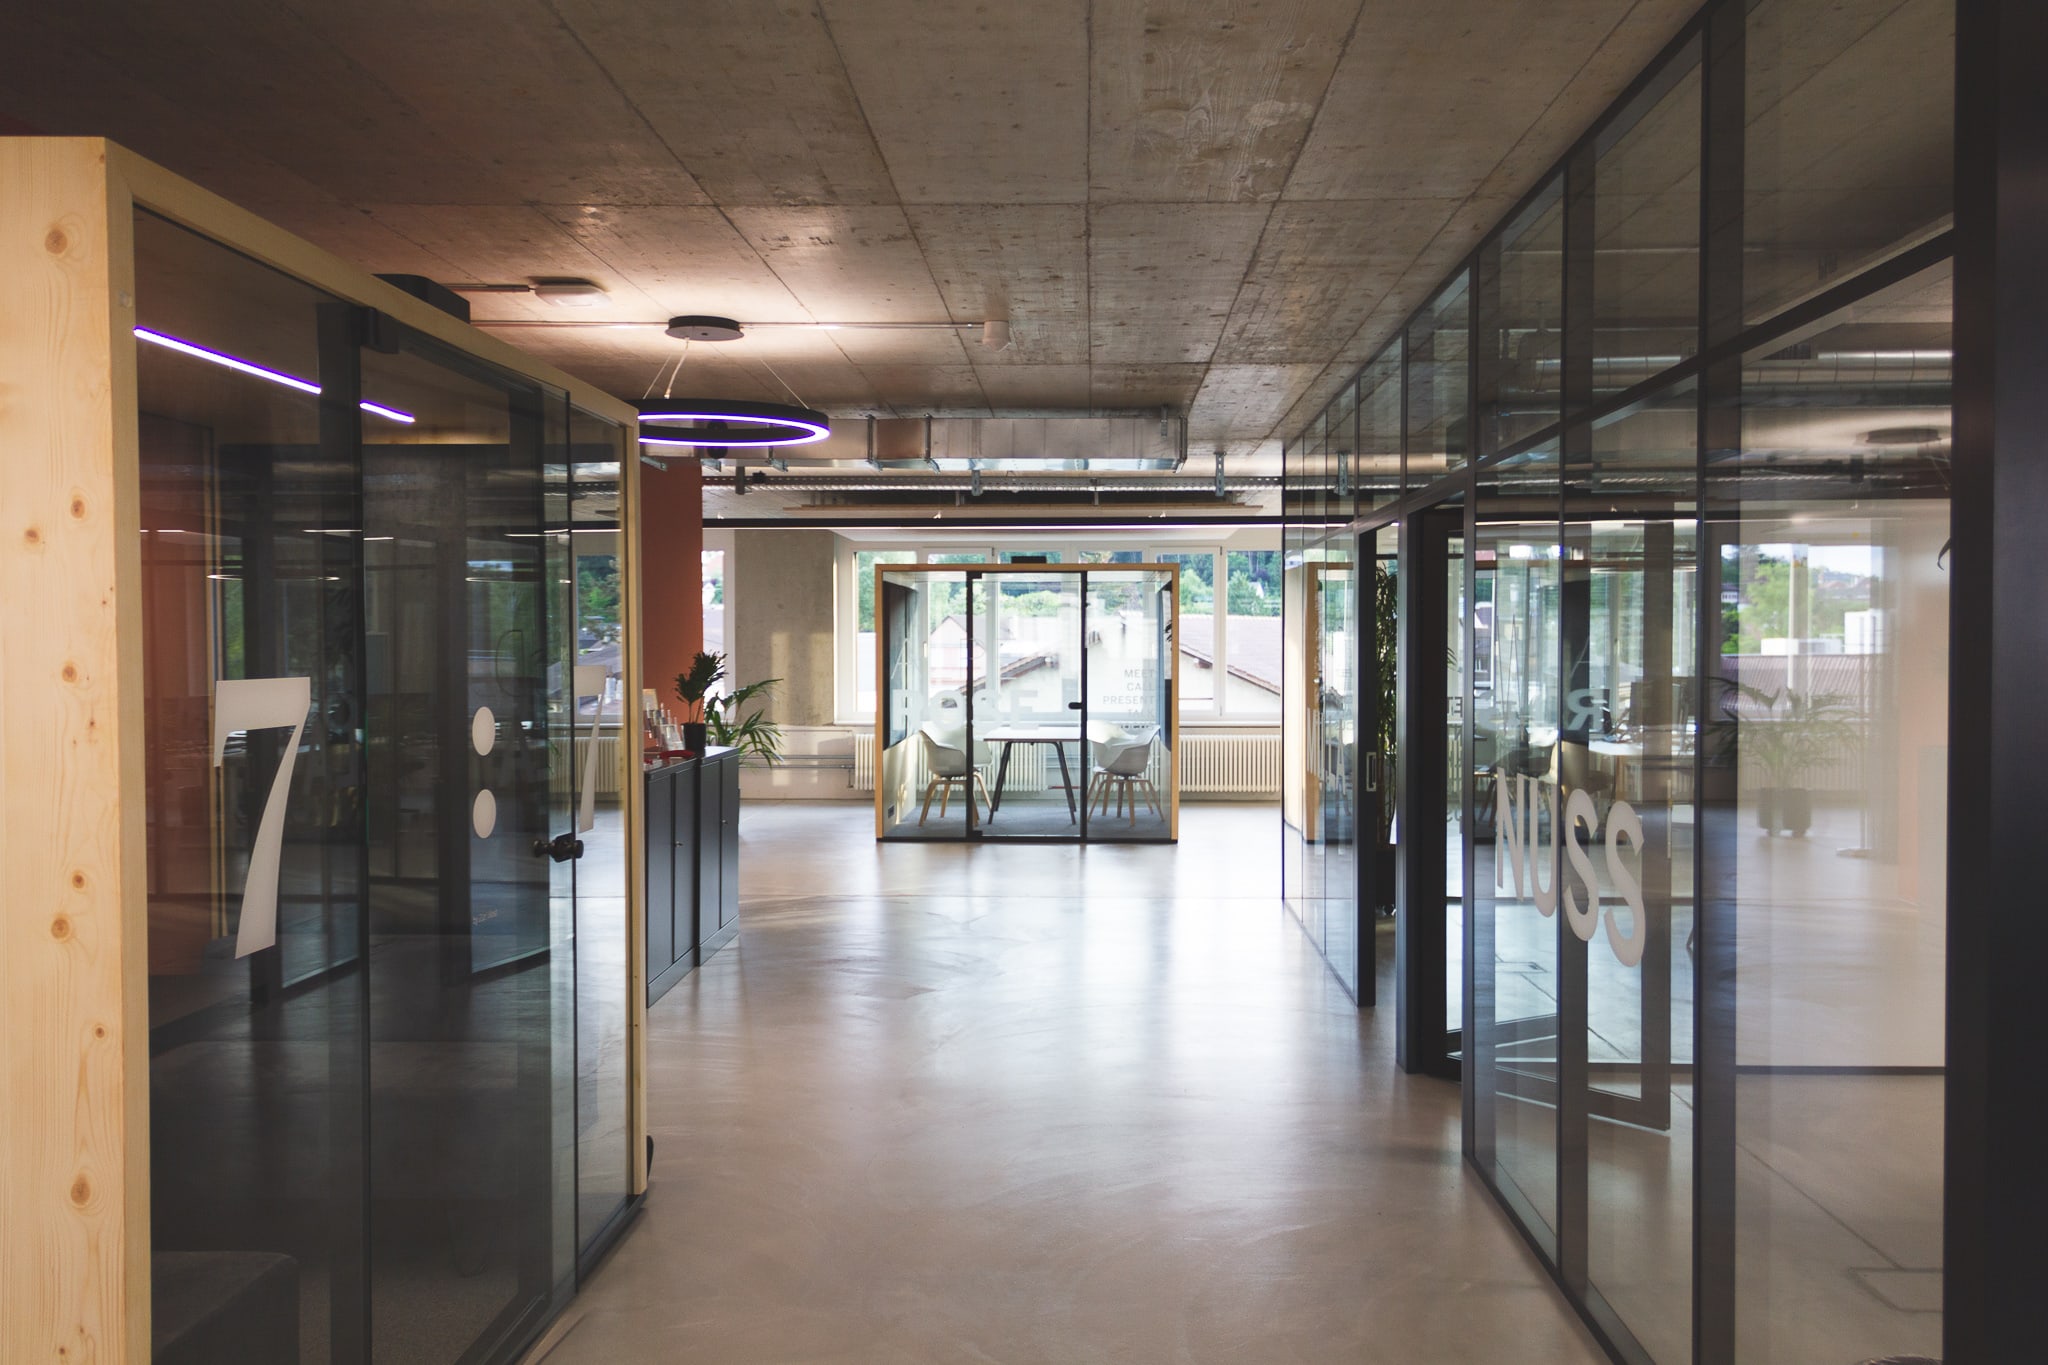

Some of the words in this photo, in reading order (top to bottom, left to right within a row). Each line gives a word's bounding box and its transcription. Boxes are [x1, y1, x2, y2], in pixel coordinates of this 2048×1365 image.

[1124, 668, 1155, 679] MEET
[1102, 695, 1155, 705] PRESENT
[1497, 766, 1646, 968] NUSS
